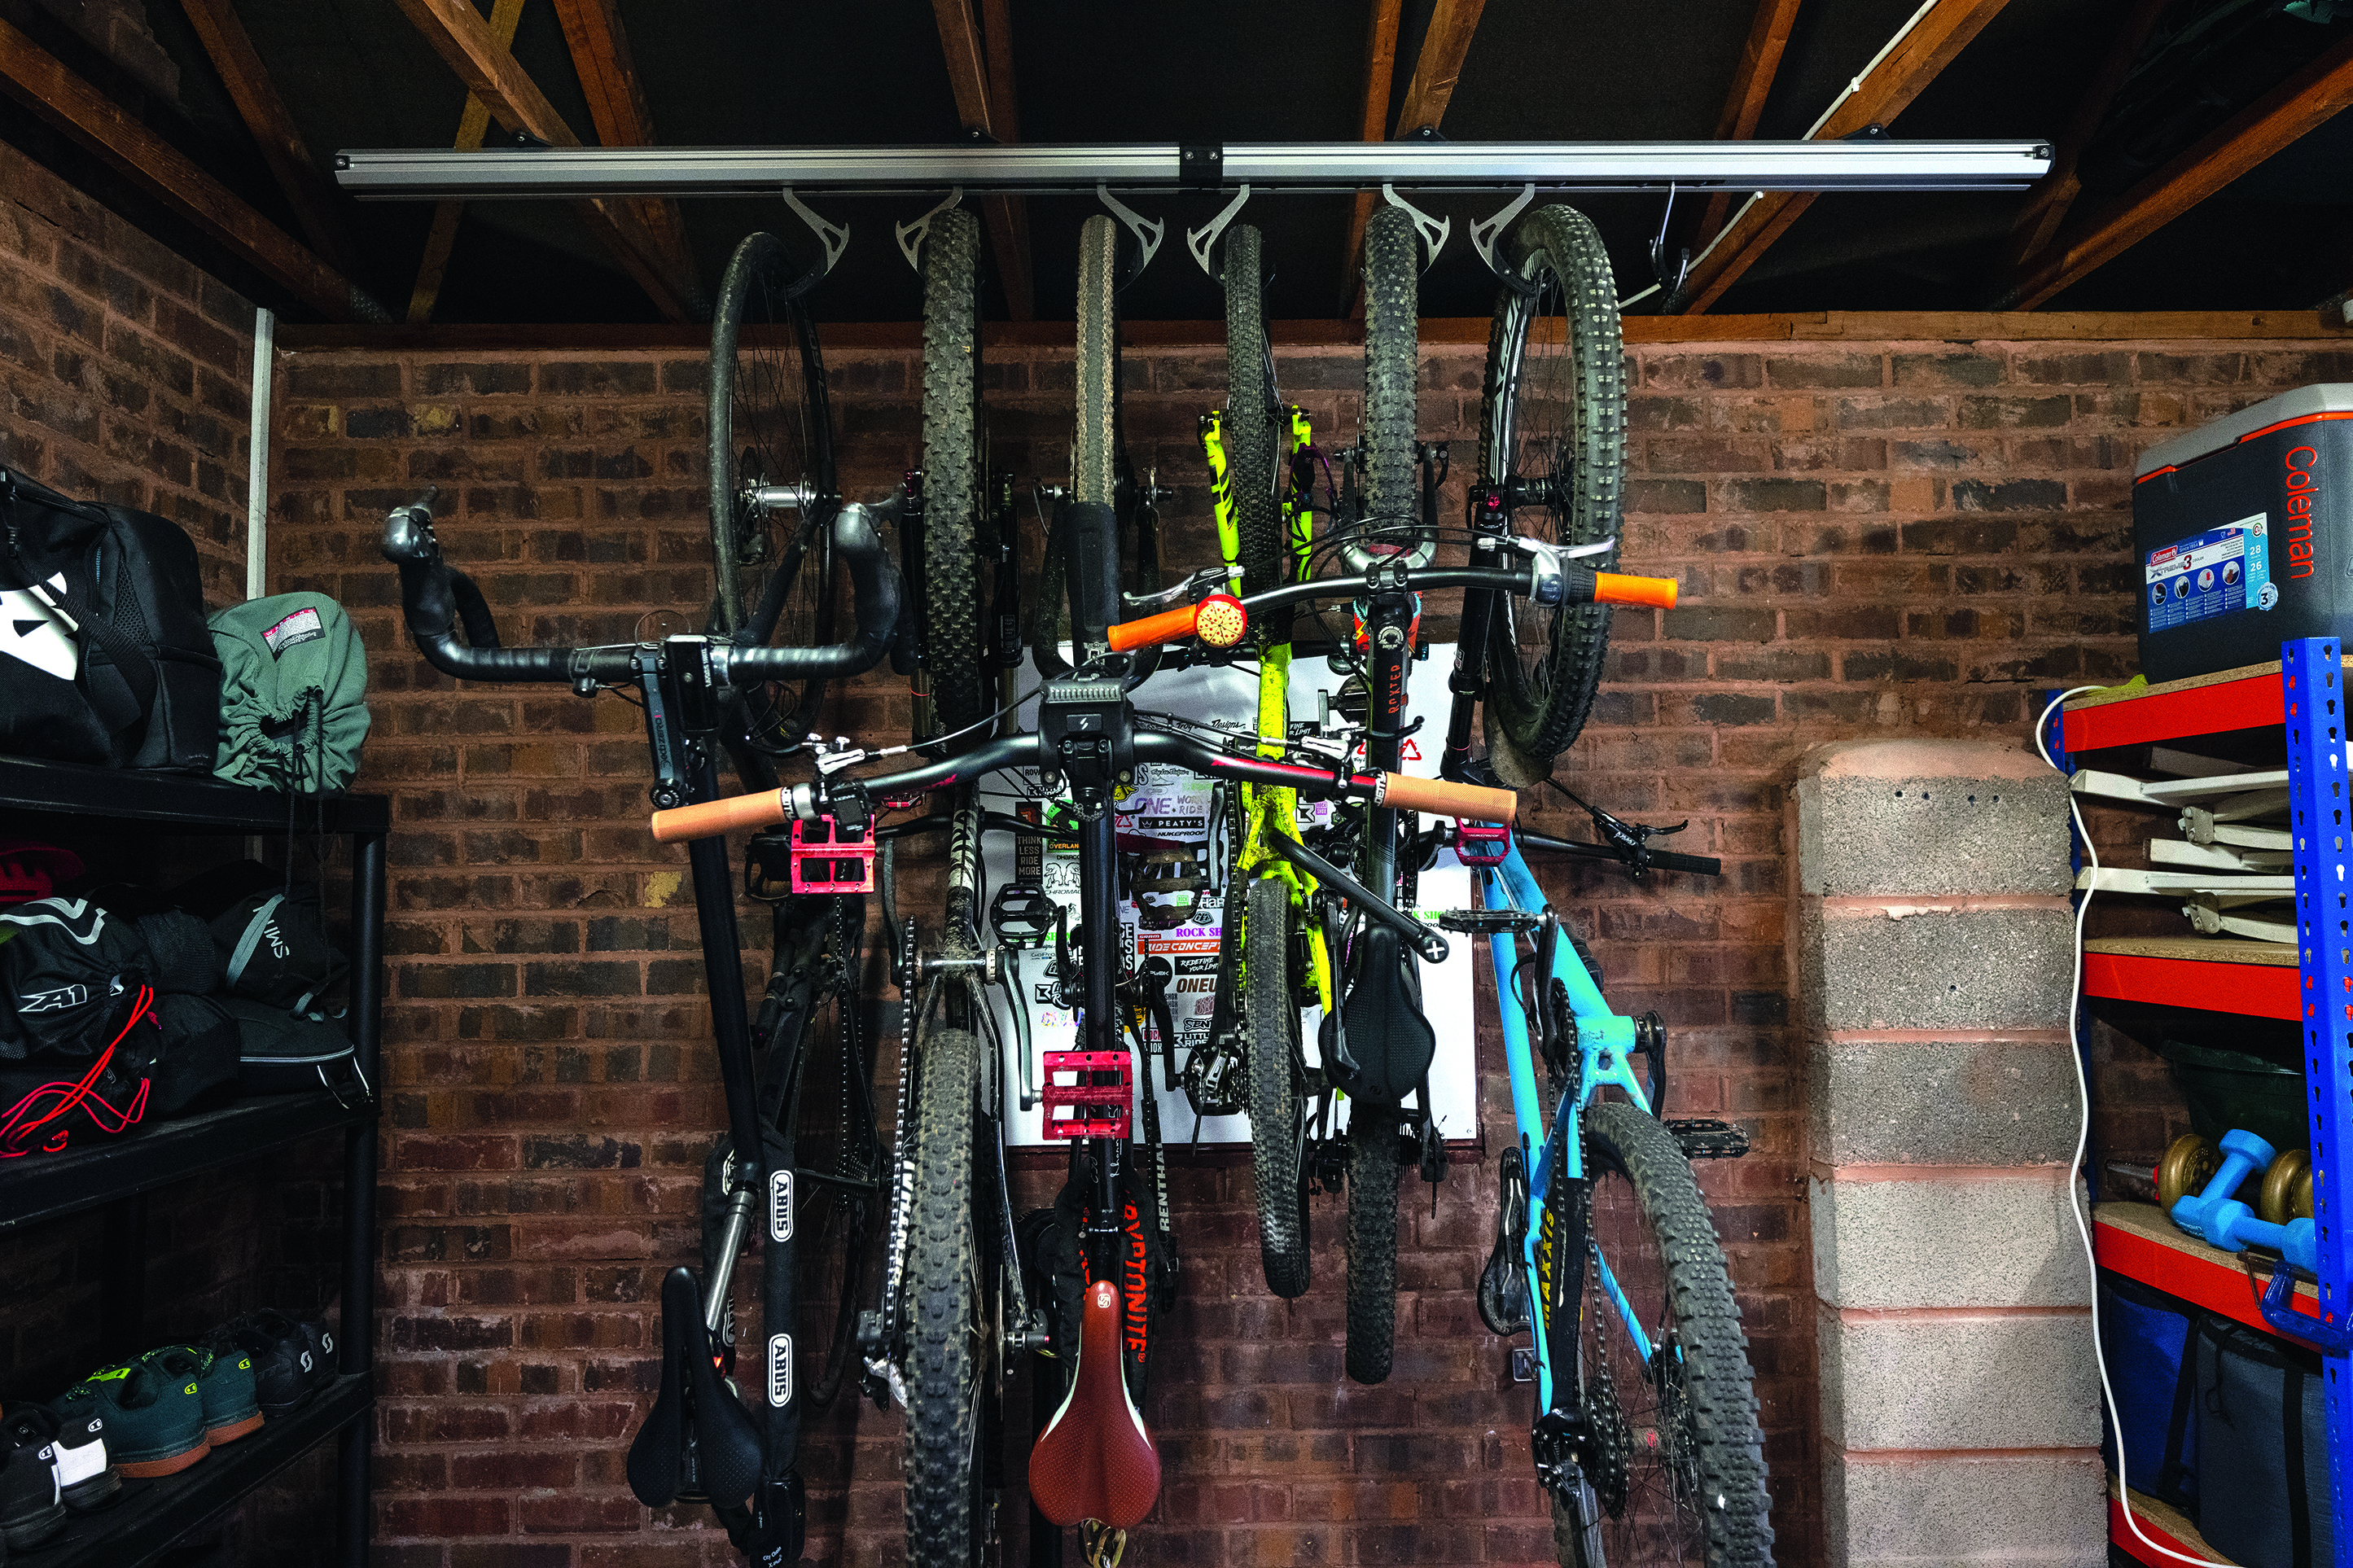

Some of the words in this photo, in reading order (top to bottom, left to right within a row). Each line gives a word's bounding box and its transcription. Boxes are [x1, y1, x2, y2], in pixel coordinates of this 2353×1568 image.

[2285, 445, 2319, 579] Coleman
[2250, 545, 2262, 556] 28
[2152, 550, 2171, 563] Coleman
[2250, 561, 2262, 572] 26
[2260, 593, 2268, 605] 3
[1387, 664, 1400, 714] ROXTER
[1212, 719, 1246, 729] Designs
[1017, 836, 1042, 845] THINK
[1019, 846, 1040, 855] LESS
[1020, 856, 1039, 865] RIDE
[1019, 866, 1041, 875] MORE
[1176, 927, 1207, 937] ROCK
[1181, 957, 1214, 966] REDEFINE
[776, 1180, 788, 1233] ABUS
[1124, 1190, 1147, 1352] RYPTONITE
[1541, 1208, 1554, 1330] MAXXIS
[774, 1343, 787, 1397] ABUS
